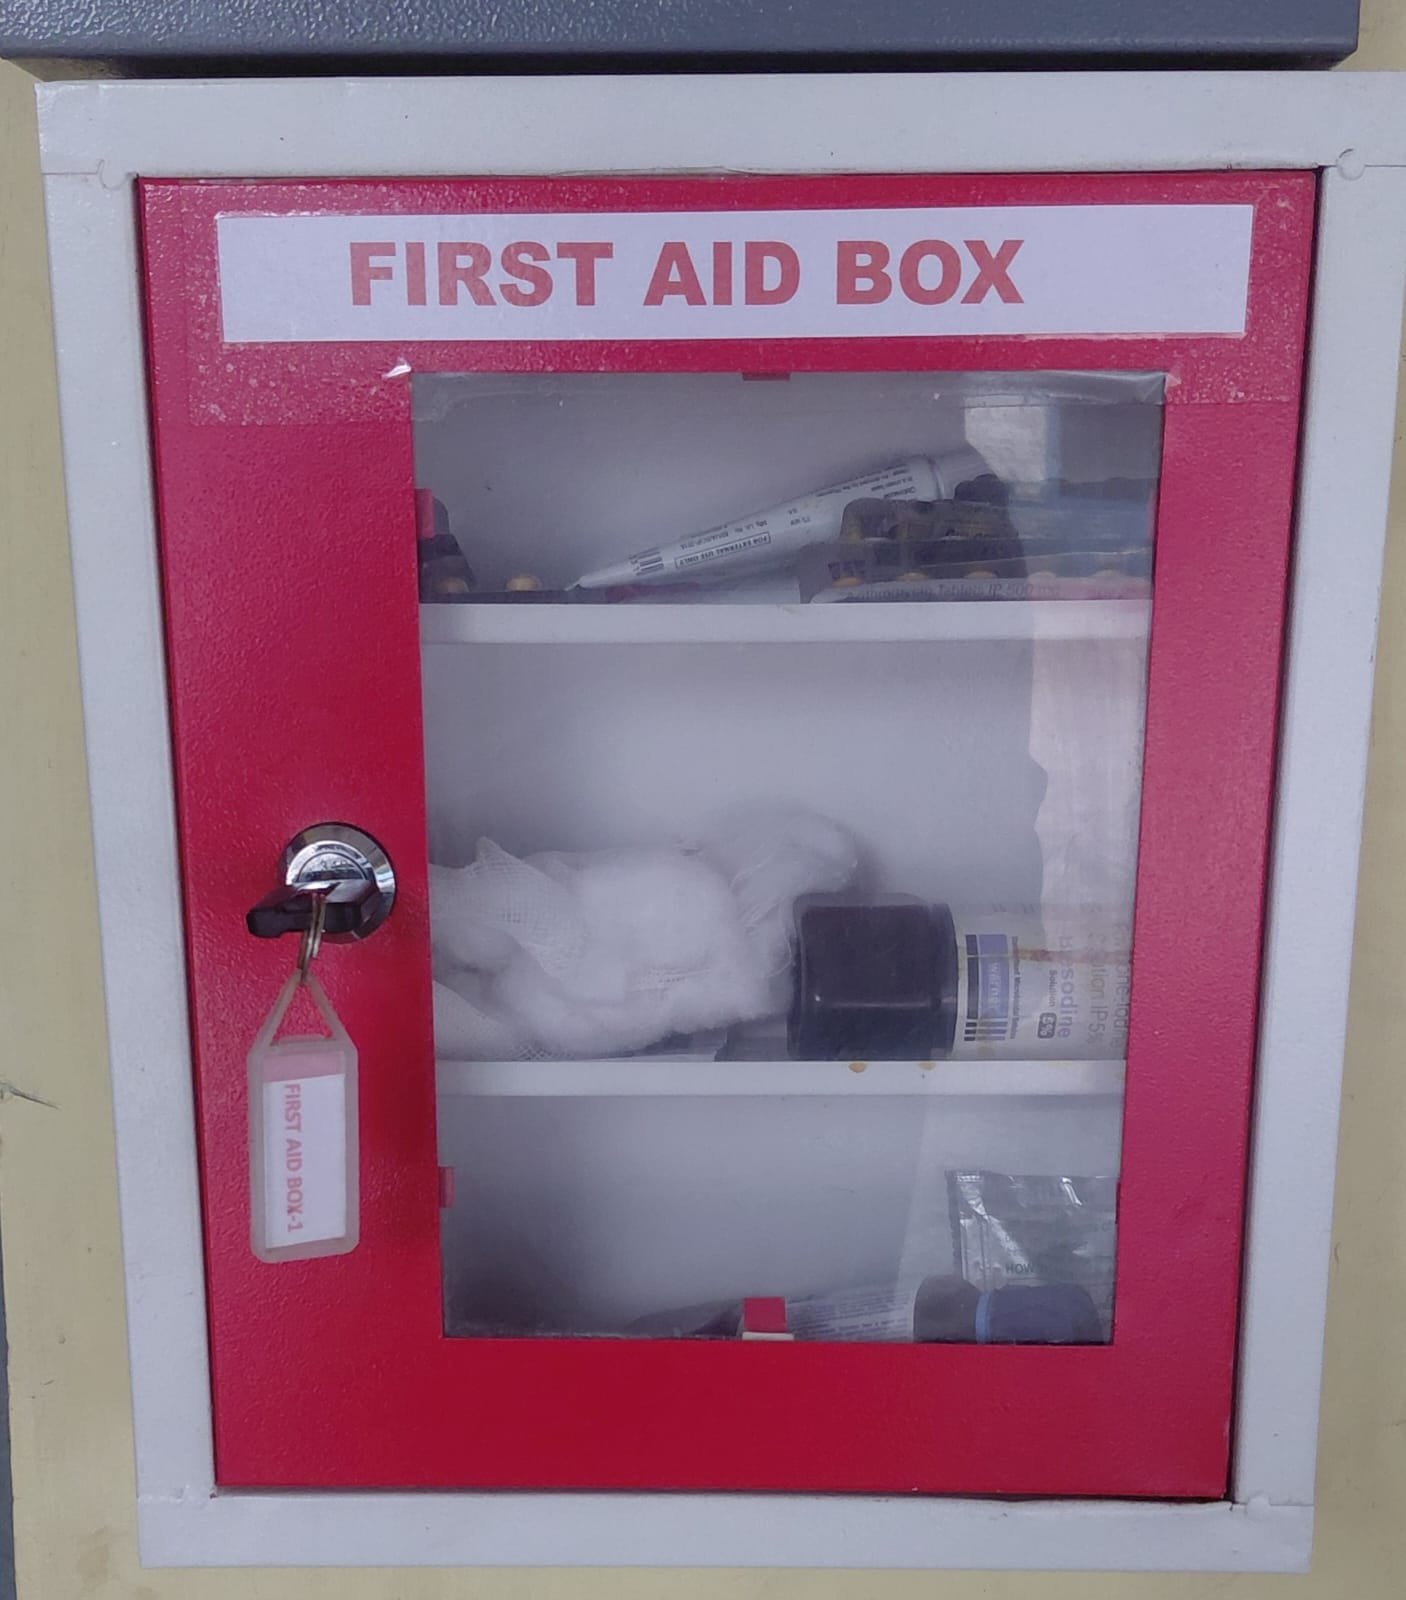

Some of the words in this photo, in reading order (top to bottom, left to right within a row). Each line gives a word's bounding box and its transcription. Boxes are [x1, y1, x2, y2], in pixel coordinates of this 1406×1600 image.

[349, 241, 613, 307] FIRST
[643, 241, 801, 306] AID
[836, 239, 1025, 306] BOX
[716, 540, 751, 557] EXTERNAL
[753, 535, 767, 545] FOR
[679, 553, 699, 566] ONLY
[701, 550, 714, 561] USE
[1089, 933, 1109, 1000] Sution
[1048, 969, 1058, 1007] Solution
[1039, 1014, 1055, 1037] 5%
[284, 1084, 302, 1133] FIRST
[286, 1138, 303, 1172] AID
[286, 1177, 304, 1233] BOX-1
[1006, 1263, 1033, 1275] HOW
